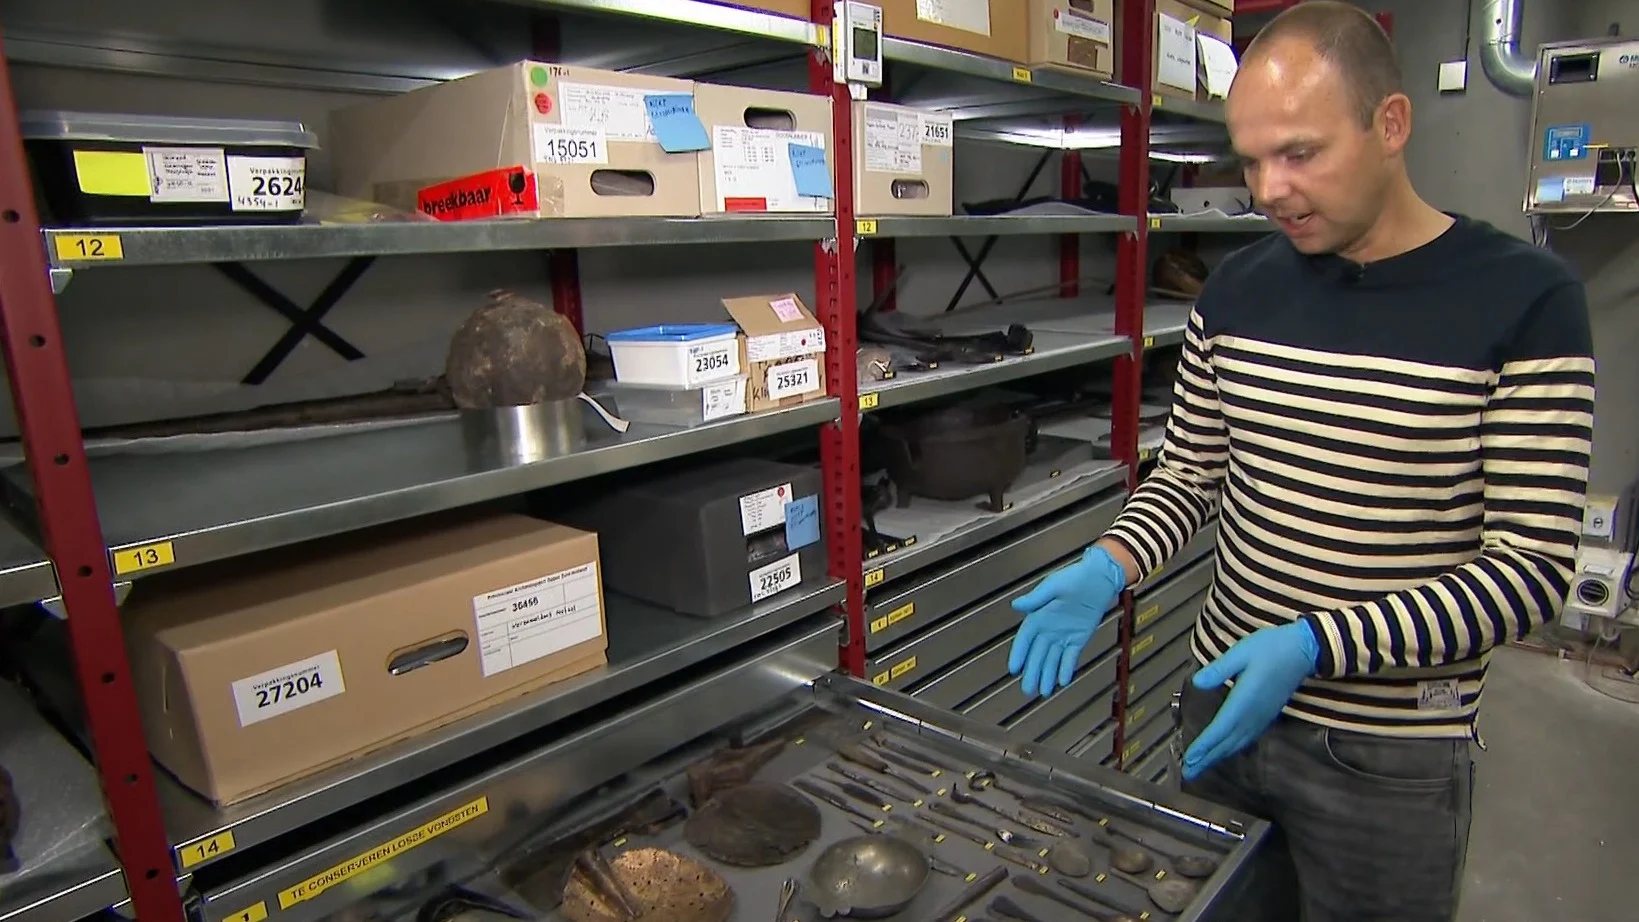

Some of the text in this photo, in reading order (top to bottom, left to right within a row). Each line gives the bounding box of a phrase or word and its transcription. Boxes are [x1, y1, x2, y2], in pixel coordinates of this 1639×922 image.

[925, 125, 949, 139] 21651
[547, 139, 597, 158] 15051
[423, 187, 492, 215] breekbaar
[862, 222, 872, 232] 12
[75, 239, 105, 256] 12
[696, 353, 729, 372] 23054
[777, 371, 808, 390] 25321
[864, 397, 873, 406] 13
[133, 549, 159, 567] 13
[760, 567, 791, 590] 22505
[870, 572, 879, 582] 14
[256, 672, 323, 708] 27204
[196, 839, 220, 859] 14
[291, 804, 480, 900] TE CONSERVEREN LOSSE VONDSTEN
